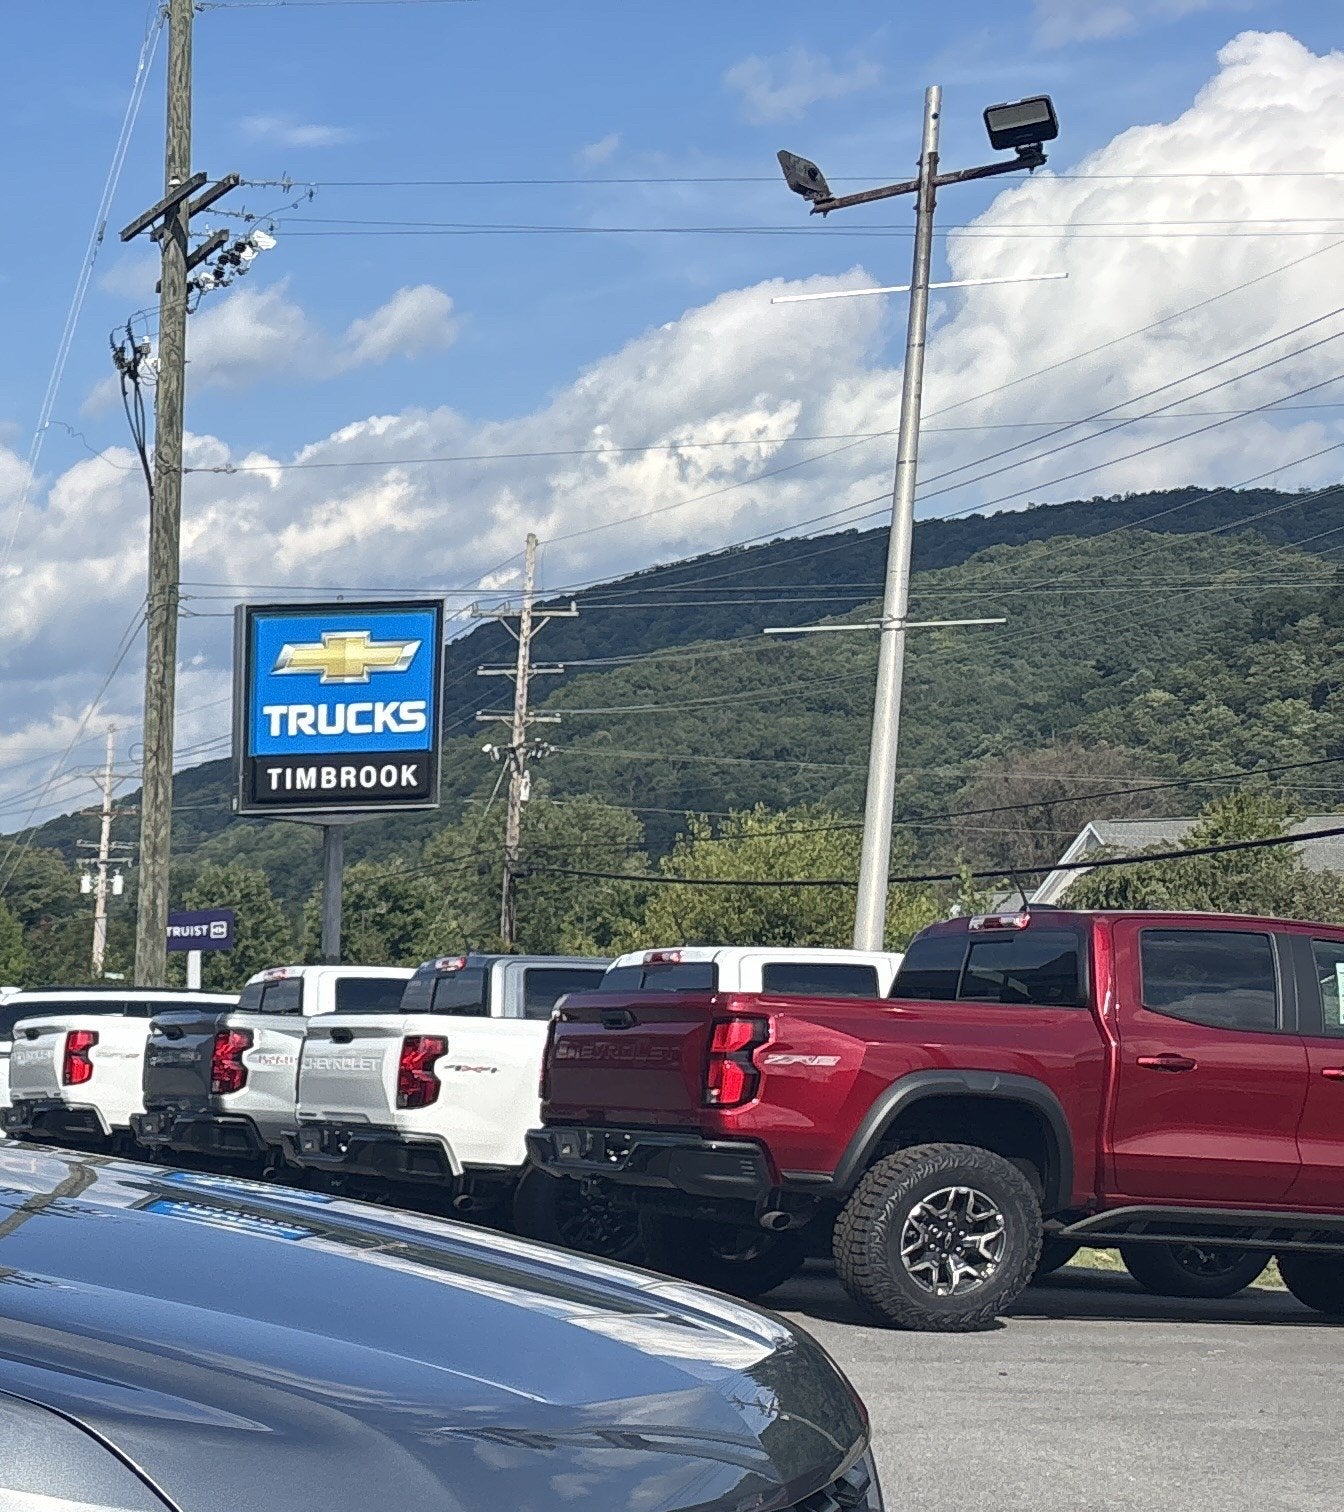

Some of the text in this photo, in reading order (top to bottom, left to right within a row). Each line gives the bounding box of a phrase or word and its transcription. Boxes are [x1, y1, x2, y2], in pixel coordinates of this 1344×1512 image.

[263, 700, 426, 737] TRUCKS
[267, 764, 418, 791] TIMBROOK
[166, 924, 209, 938] TRUIST
